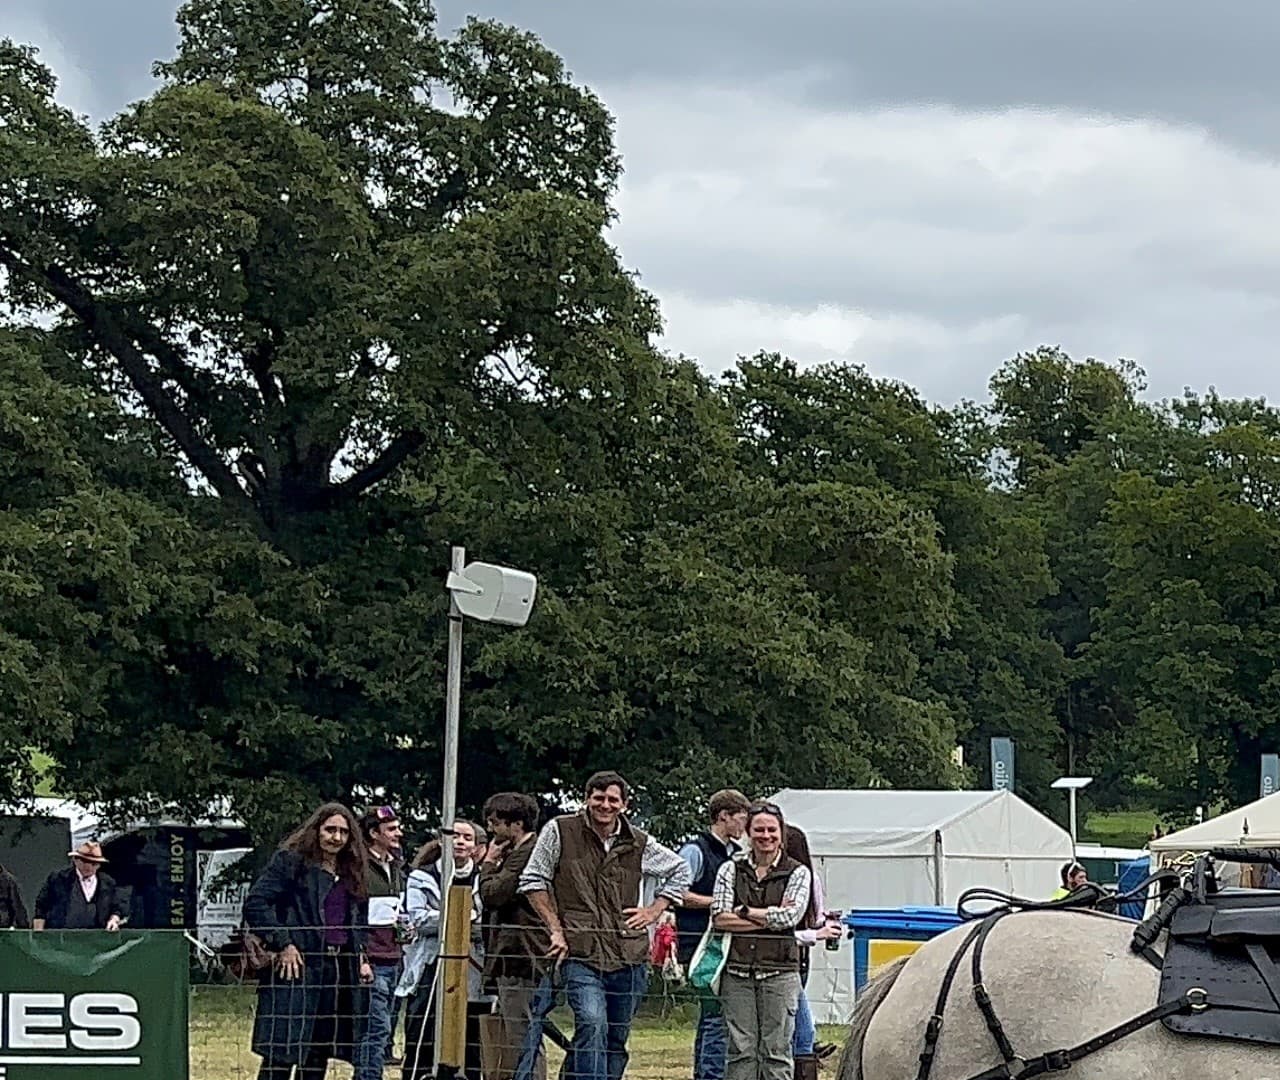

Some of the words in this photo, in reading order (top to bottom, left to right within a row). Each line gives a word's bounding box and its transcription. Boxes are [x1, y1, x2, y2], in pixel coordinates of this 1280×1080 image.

[170, 834, 184, 883] ENJOY
[170, 899, 184, 926] EAT
[0, 993, 141, 1050] ES
